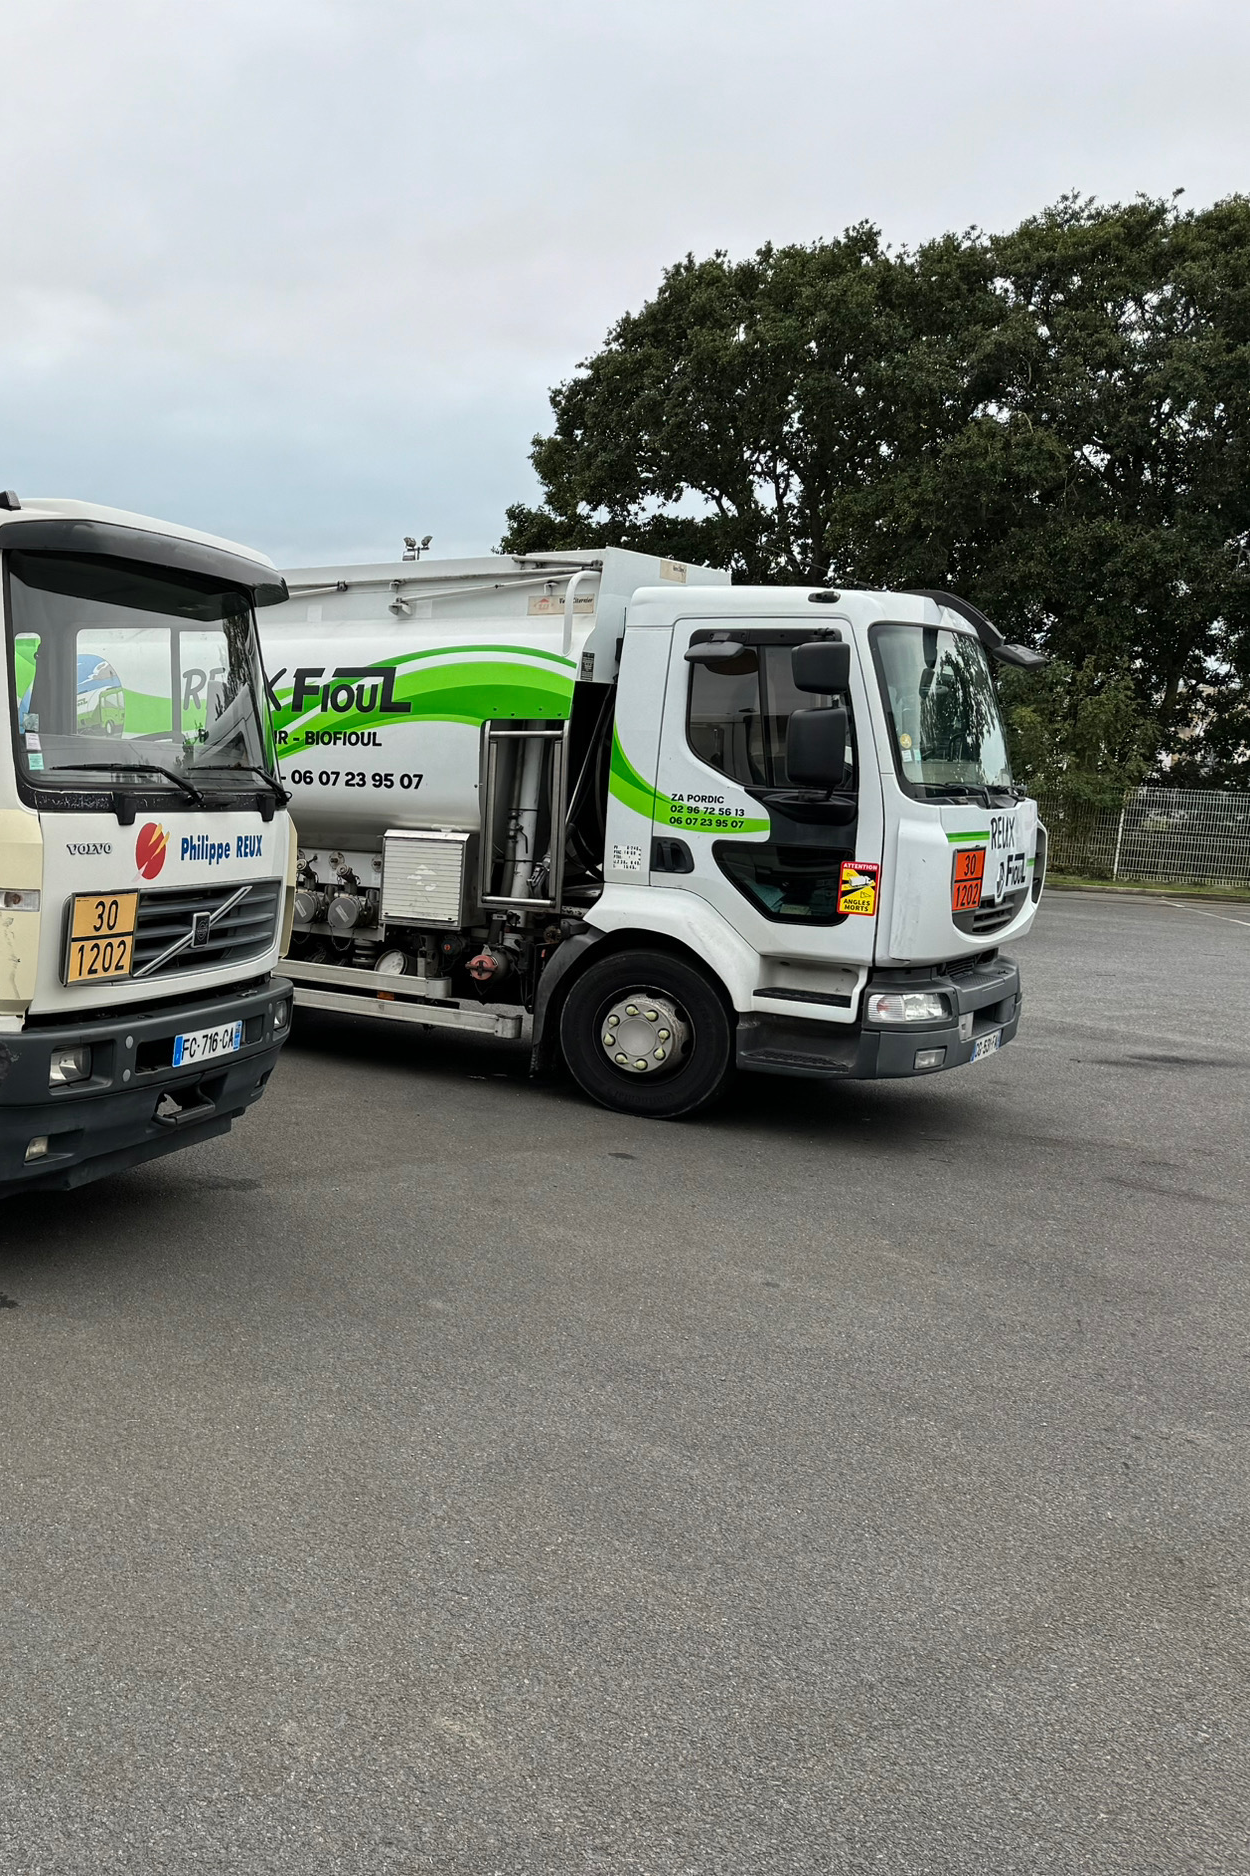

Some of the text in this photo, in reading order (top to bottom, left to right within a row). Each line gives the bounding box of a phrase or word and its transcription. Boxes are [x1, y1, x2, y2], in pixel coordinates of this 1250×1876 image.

[305, 730, 382, 747] BIOFIOUL
[291, 769, 314, 786] 06
[318, 770, 341, 787] 07
[344, 771, 367, 788] 23
[371, 772, 395, 789] 95
[399, 773, 424, 790] 07
[670, 793, 725, 804] ZA PORDIC
[670, 805, 745, 817] 02 96 72 56 13
[669, 816, 744, 829] 06 07 23 95 07
[66, 842, 112, 856] VOLVO
[181, 834, 262, 865] Philippe REUX
[963, 853, 977, 877] 30
[843, 898, 871, 906] ANGLES
[955, 882, 979, 907] 1202
[93, 899, 119, 932] 30
[844, 904, 869, 912] MORTS
[77, 939, 127, 977] 1202
